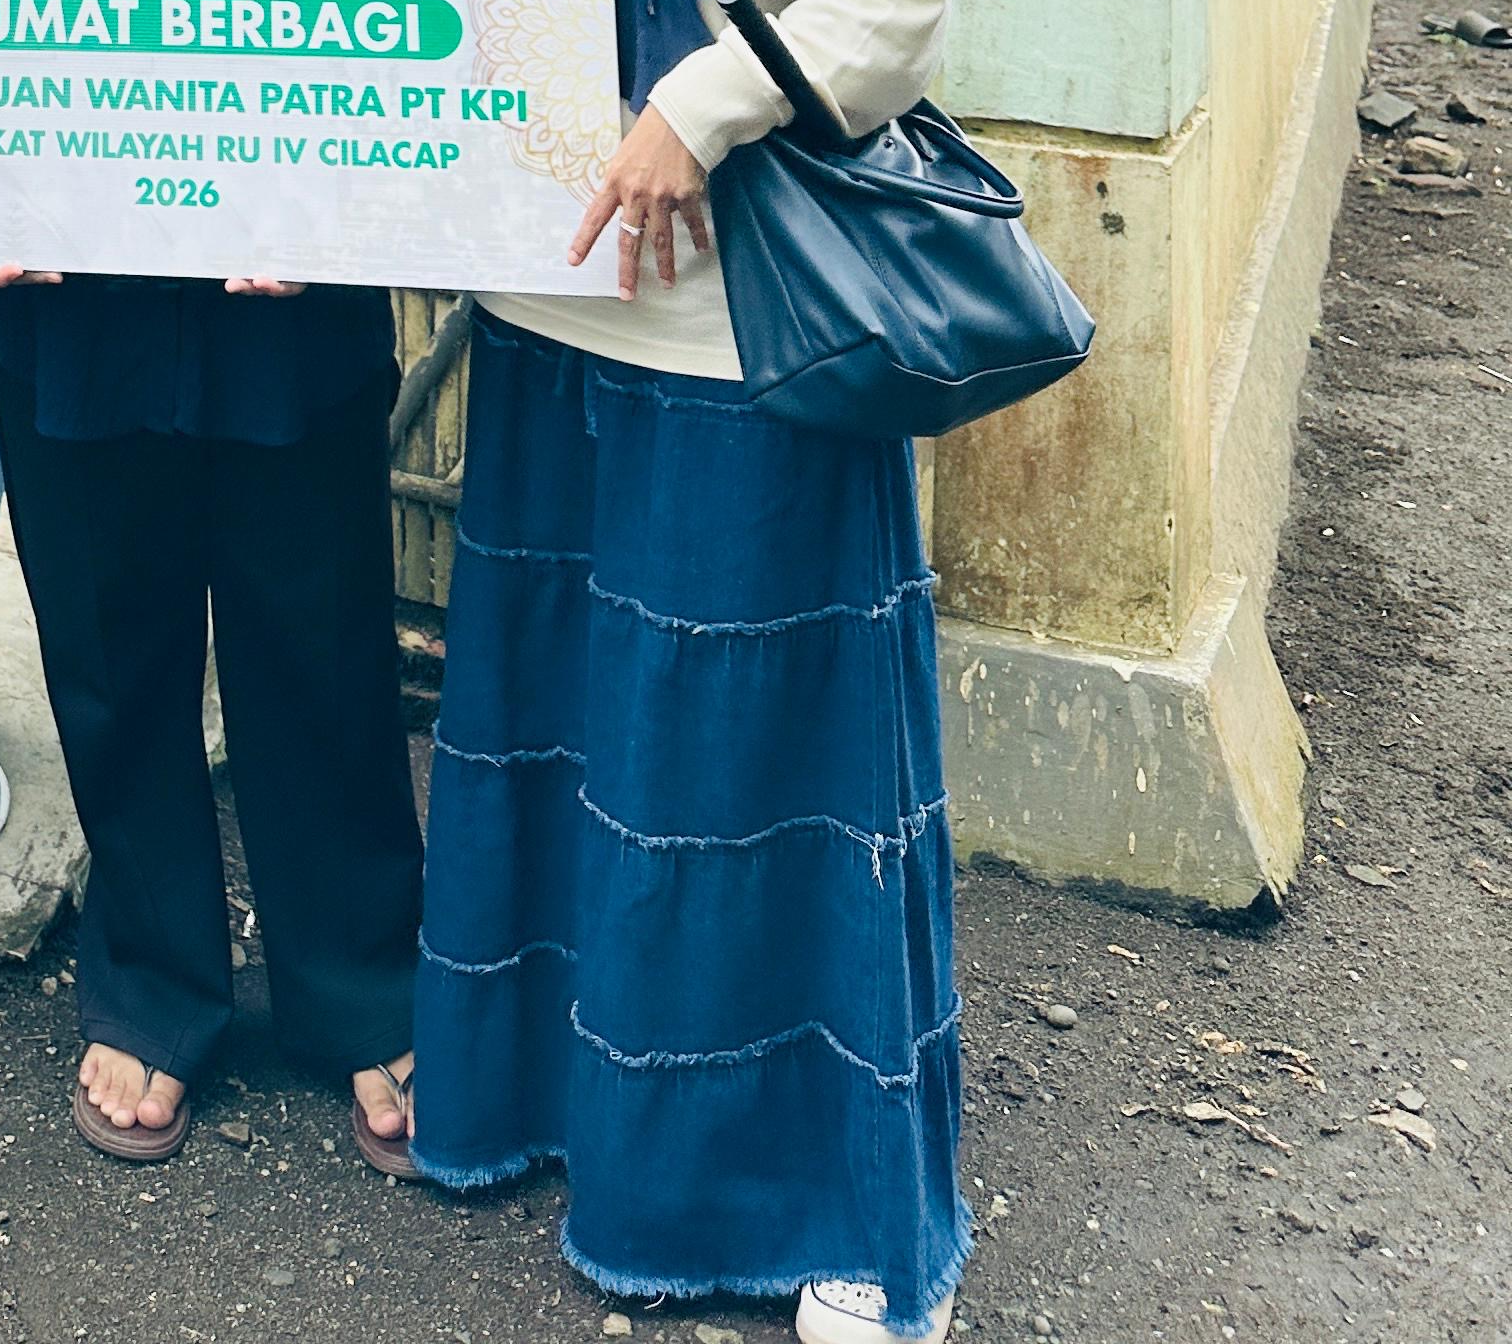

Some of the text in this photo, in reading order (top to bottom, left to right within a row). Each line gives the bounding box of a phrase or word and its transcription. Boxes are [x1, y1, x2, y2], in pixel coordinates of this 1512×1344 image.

[85, 78, 245, 112] WANITA
[260, 82, 386, 117] PATRA
[401, 86, 446, 119] PT
[461, 88, 527, 122] KPI
[56, 131, 203, 160] WILAYAH
[217, 136, 260, 163] RU
[274, 137, 307, 164] IV
[319, 138, 460, 169] CILACAP
[136, 177, 220, 208] 2026
